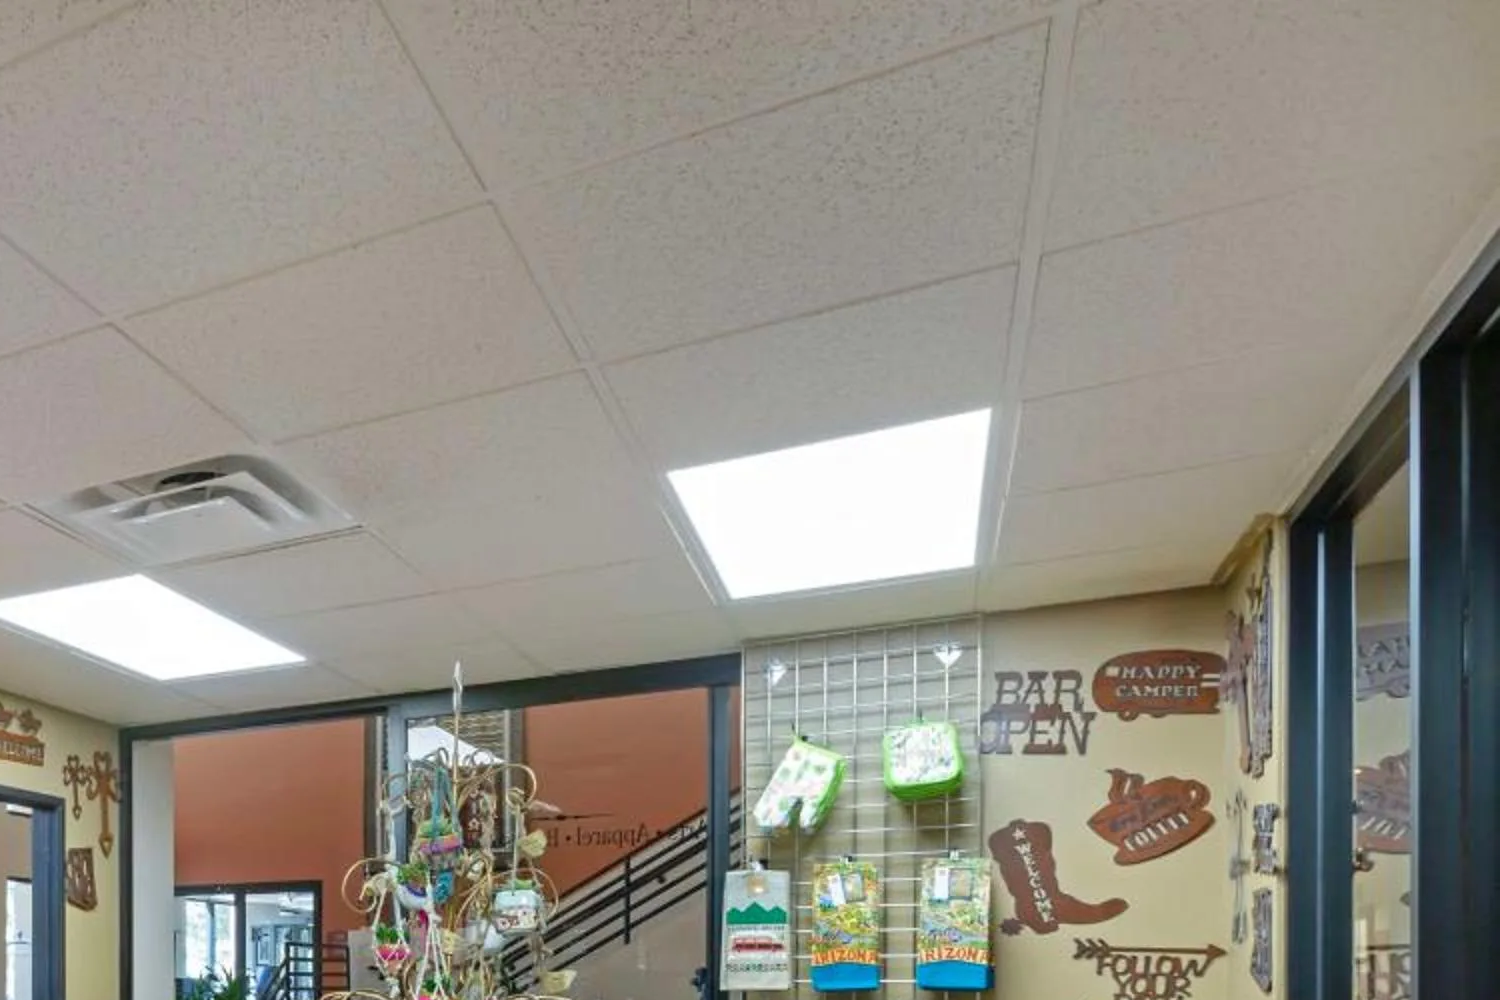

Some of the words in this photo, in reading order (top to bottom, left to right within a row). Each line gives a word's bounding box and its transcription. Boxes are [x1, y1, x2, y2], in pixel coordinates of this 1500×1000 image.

[1120, 666, 1201, 679] HAPPY
[995, 669, 1085, 712] BAR
[1115, 685, 1200, 697] CAMPER
[980, 711, 1098, 756] OPEN
[1014, 842, 1058, 923] WELCOME
[811, 946, 878, 965] ARIZONA
[1096, 954, 1211, 978] FOLLOW
[1113, 974, 1192, 998] YOUR
